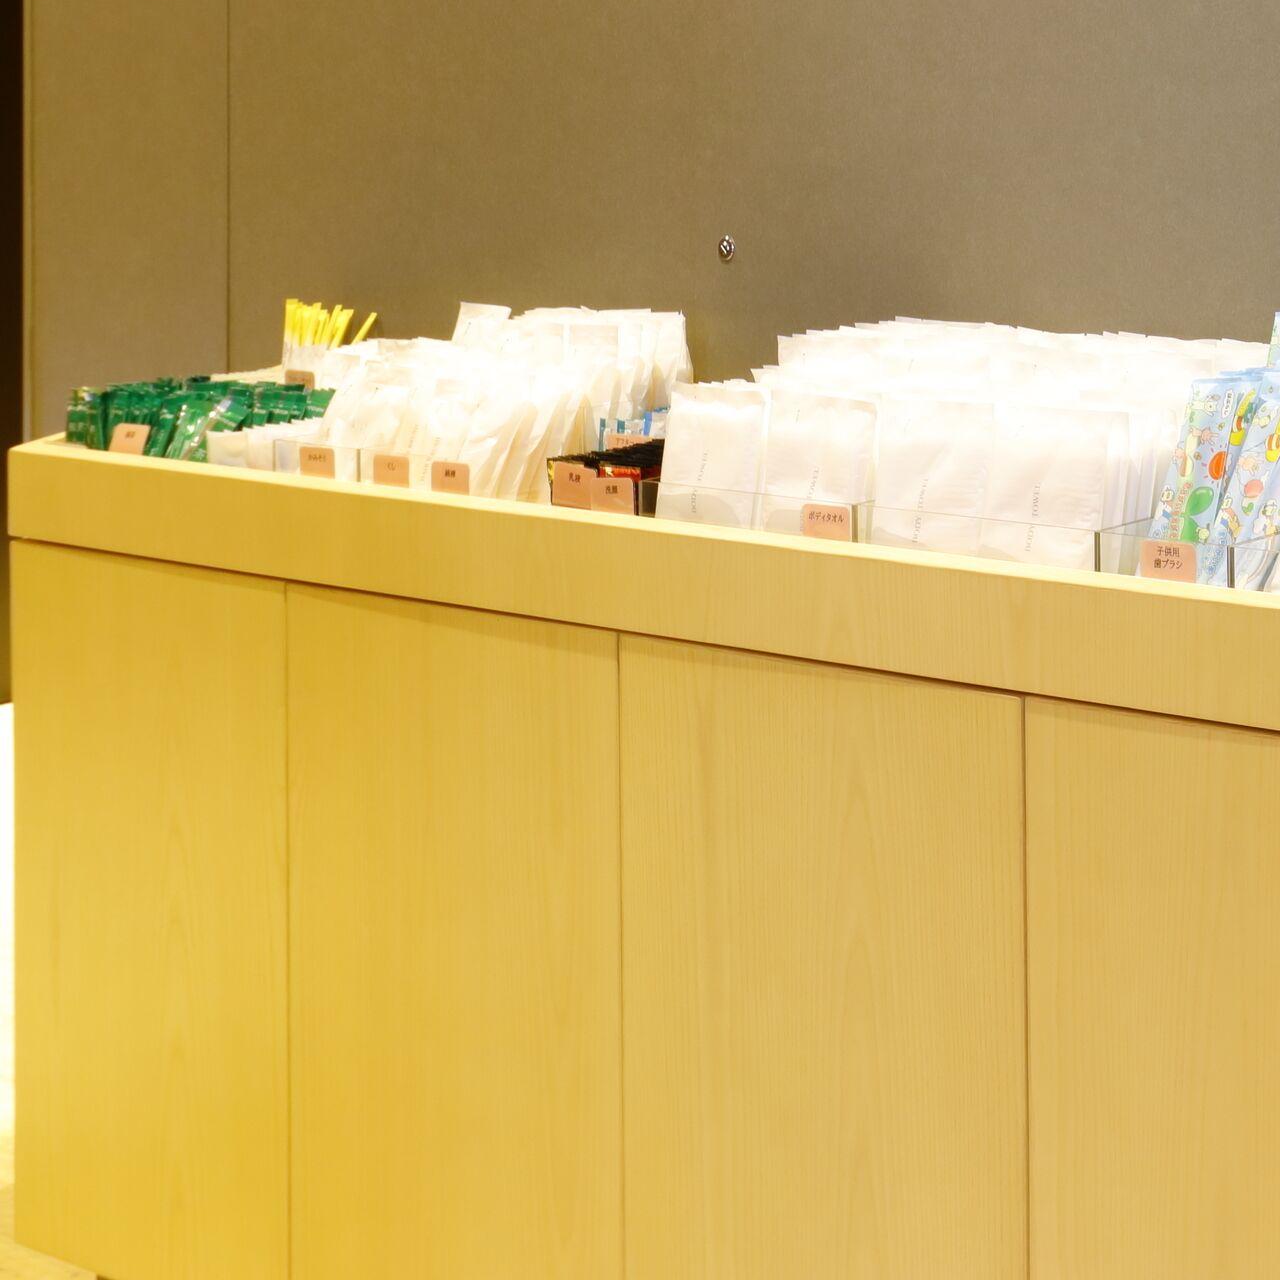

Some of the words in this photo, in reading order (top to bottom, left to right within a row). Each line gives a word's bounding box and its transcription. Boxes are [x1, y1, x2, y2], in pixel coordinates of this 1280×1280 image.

[808, 510, 845, 524] ボディタオル
[1157, 546, 1180, 558] 子供用
[1153, 558, 1183, 570] 歯ブラシ
